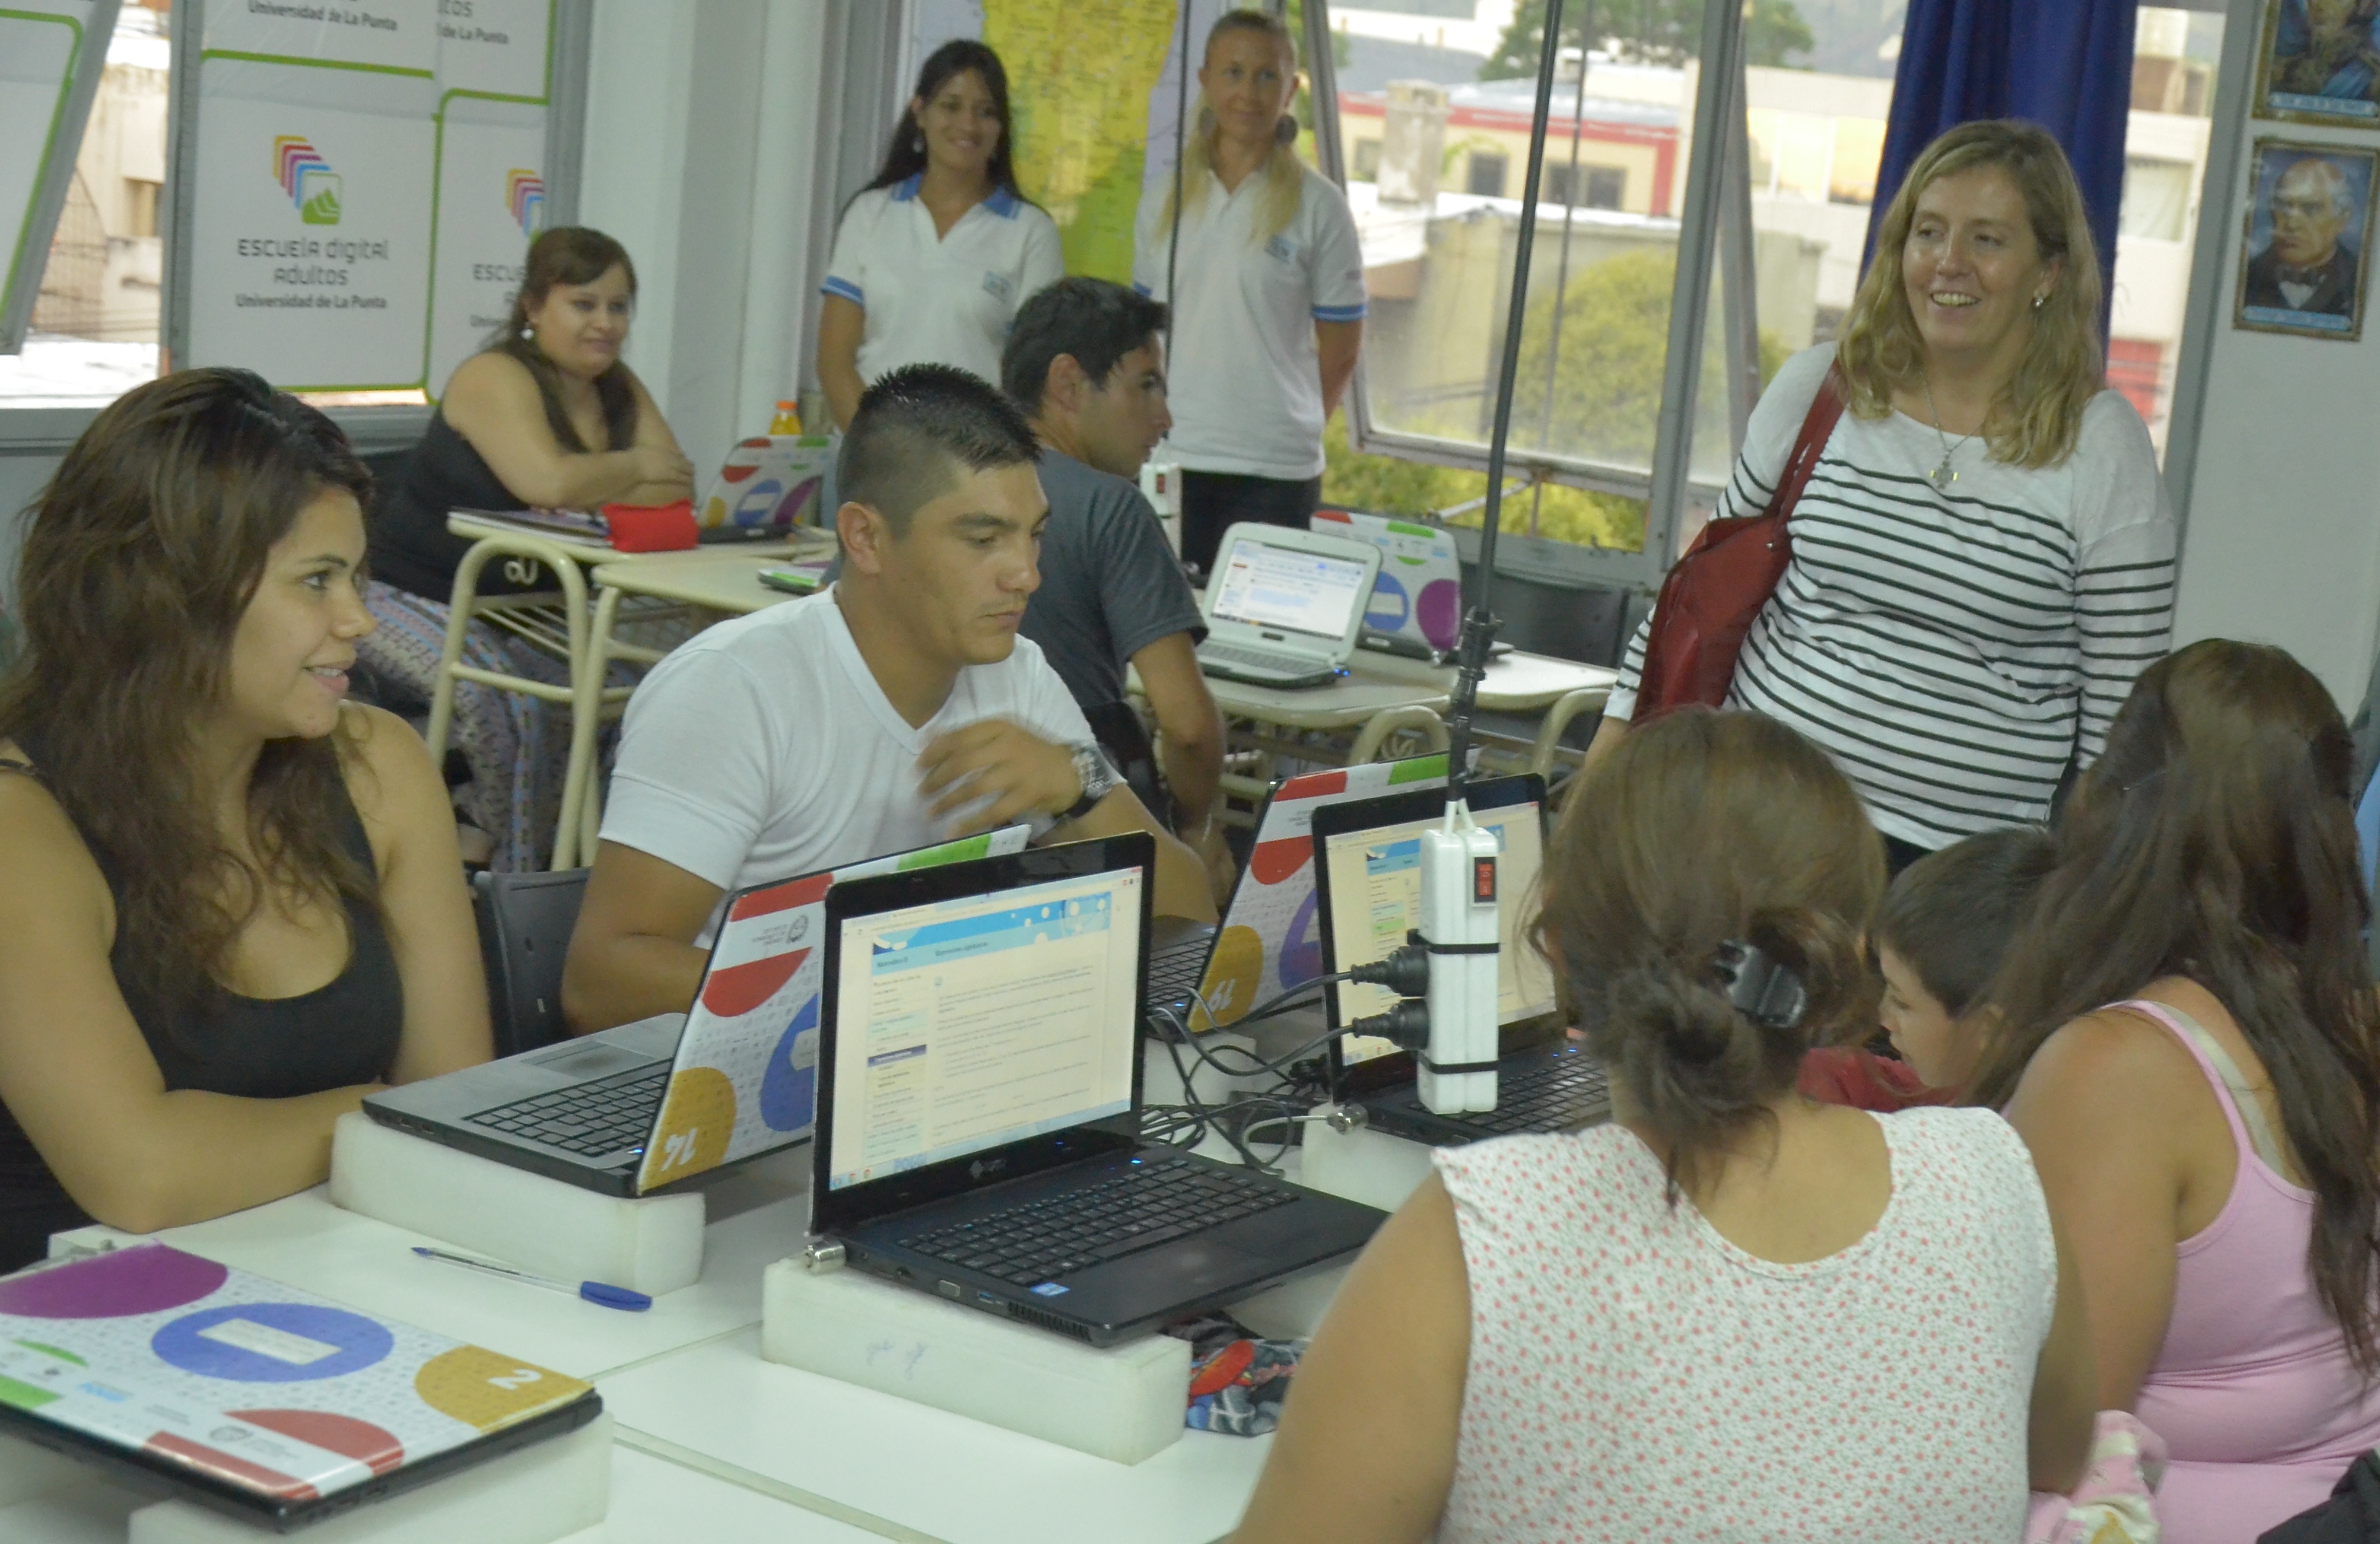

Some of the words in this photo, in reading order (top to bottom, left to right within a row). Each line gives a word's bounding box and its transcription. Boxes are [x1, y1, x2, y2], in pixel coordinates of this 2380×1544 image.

[248, 0, 324, 20] Universidad
[328, 8, 341, 23] de
[344, 11, 358, 25] La
[361, 12, 398, 31] Punta
[459, 26, 472, 40] La
[475, 27, 509, 45] Punta
[235, 293, 313, 307] Universidad
[316, 294, 331, 308] de
[333, 294, 348, 308] La
[351, 294, 387, 308] Punta
[486, 1368, 542, 1390] 2
